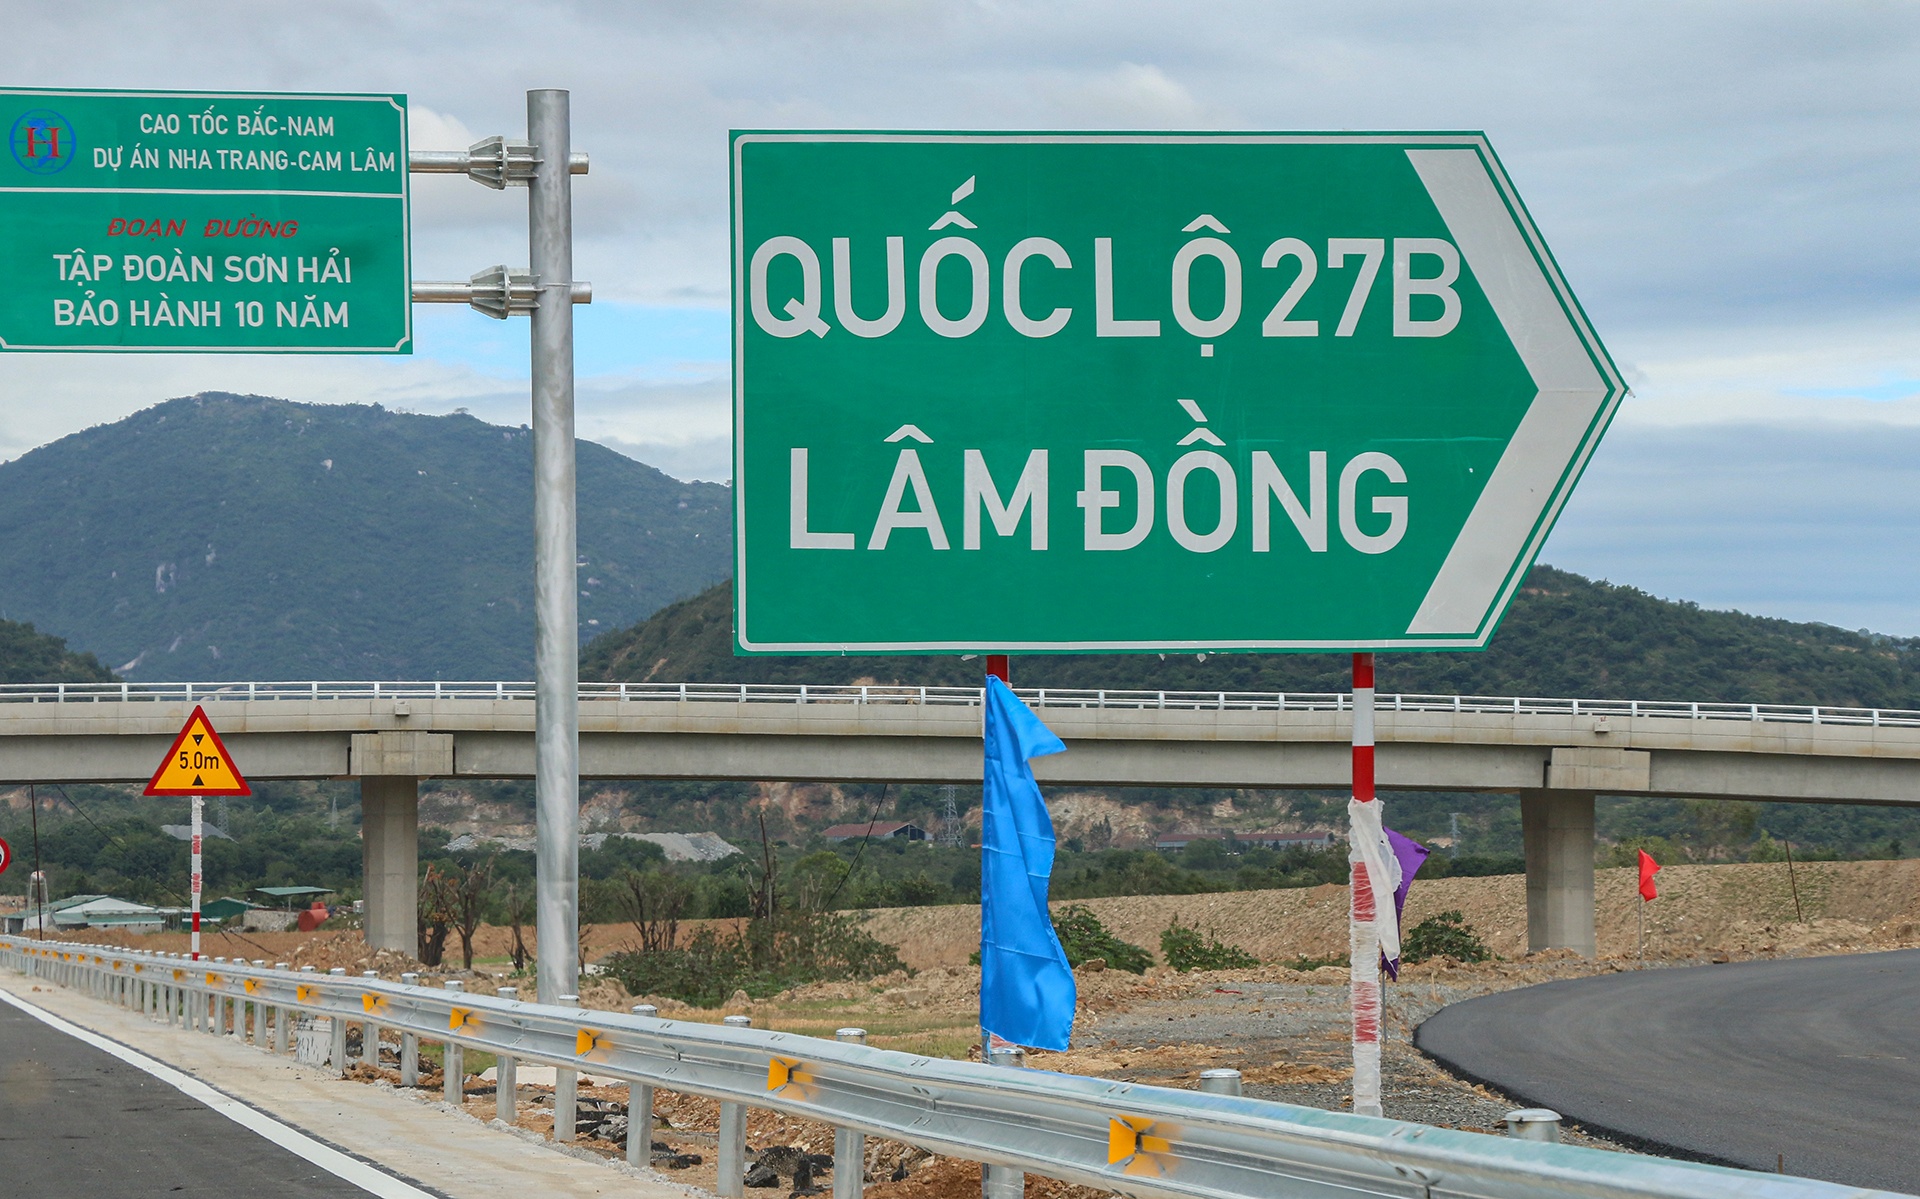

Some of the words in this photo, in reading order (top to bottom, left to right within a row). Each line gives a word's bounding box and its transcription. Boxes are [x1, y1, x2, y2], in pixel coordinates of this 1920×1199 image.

[140, 113, 180, 135] CAO
[188, 105, 229, 135] TỐC
[237, 105, 334, 137] BẮC-NAM
[93, 145, 124, 172] DỰ
[130, 142, 159, 169] ÁN
[168, 149, 213, 170] NHA
[216, 149, 342, 171] TRANG-CAM
[350, 146, 395, 172] LÂM
[106, 217, 187, 242] ĐOẠN
[204, 212, 299, 238] ĐƯỜNG
[53, 247, 113, 287] TẬP
[123, 247, 213, 282] ĐOÀN
[224, 253, 288, 283] SƠN
[297, 247, 351, 283] HẢI
[750, 175, 1073, 339] QUỐC
[1094, 214, 1243, 357] LỘ
[1261, 236, 1463, 338] 27B
[53, 289, 119, 327] BẢO
[129, 291, 221, 328] HÀNH
[234, 301, 264, 327] 10
[276, 293, 349, 328] NĂM
[790, 424, 1049, 551] LÂM
[1077, 398, 1410, 555] ĐỒNG
[179, 751, 219, 770] 5.0m
